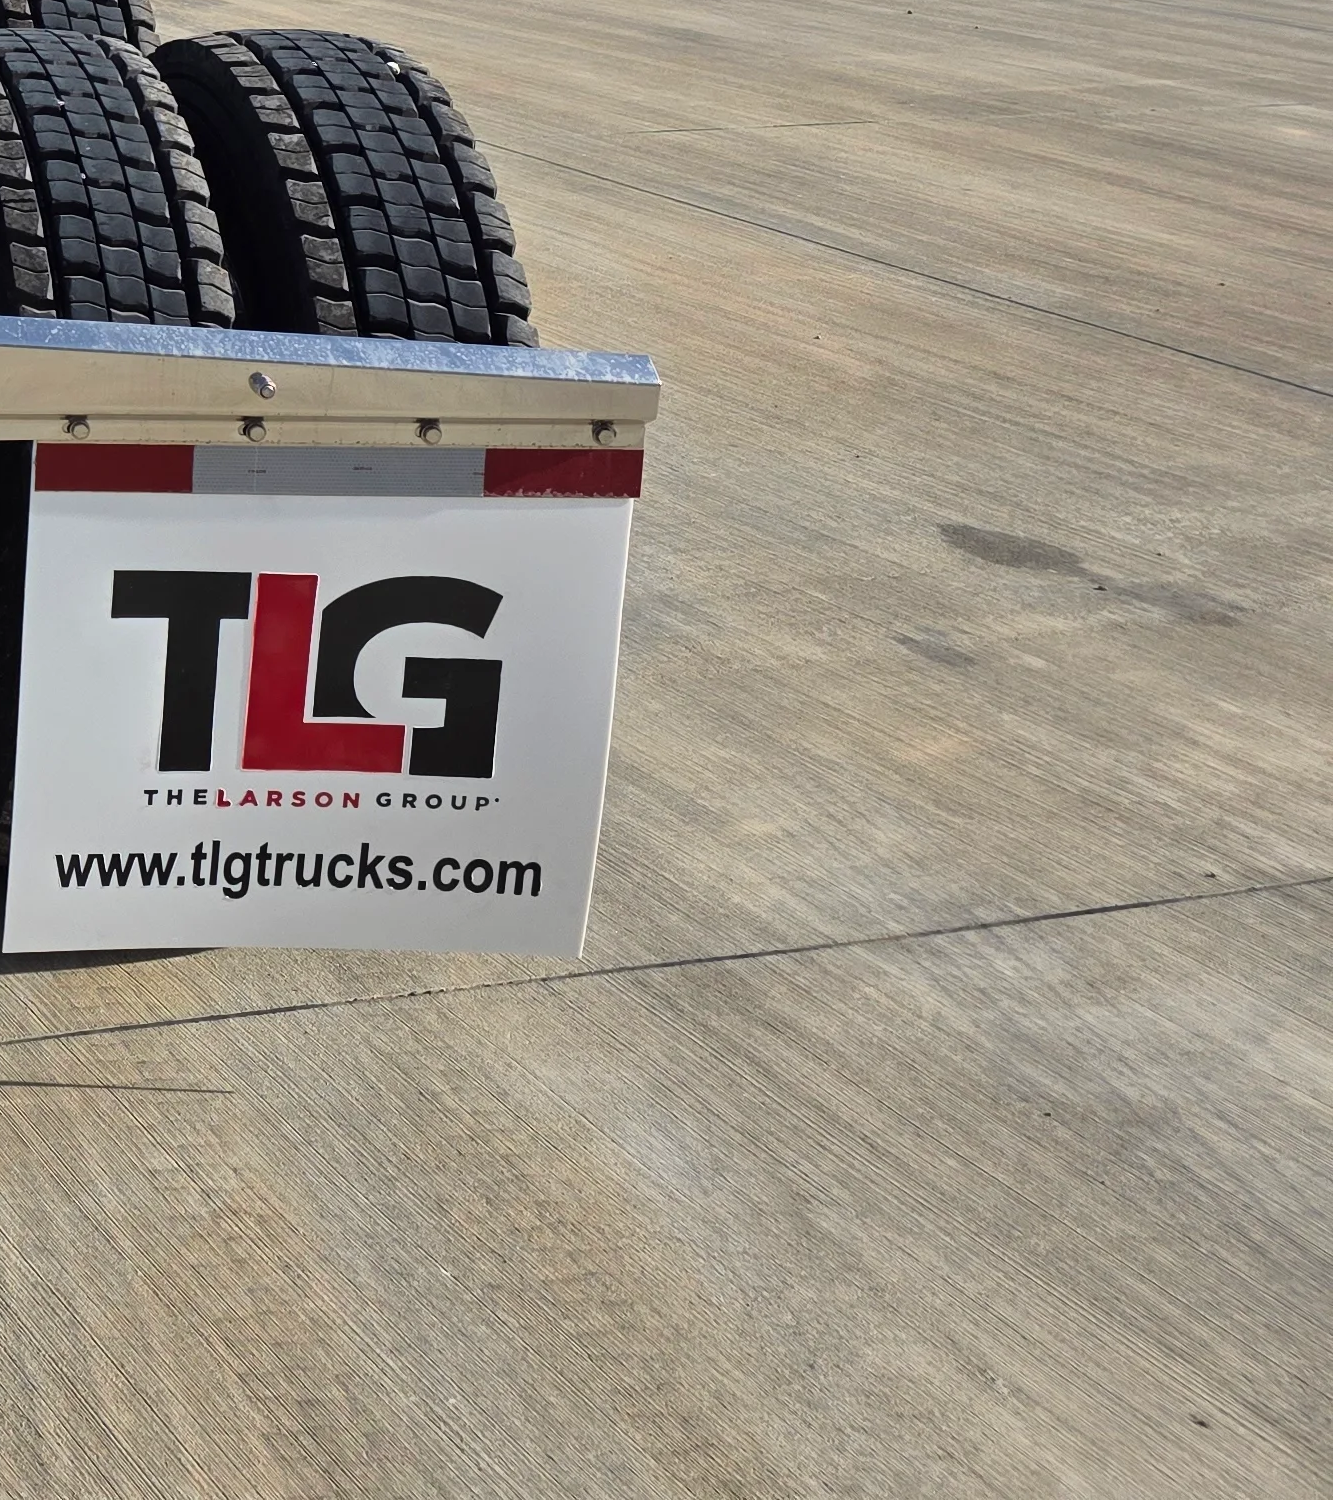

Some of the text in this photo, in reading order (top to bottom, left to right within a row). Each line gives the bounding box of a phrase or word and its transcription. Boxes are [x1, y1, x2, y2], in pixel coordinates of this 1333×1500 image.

[111, 570, 503, 778] TLG
[376, 793, 491, 811] GROUP
[55, 841, 541, 899] www.tlgtrucks.com
